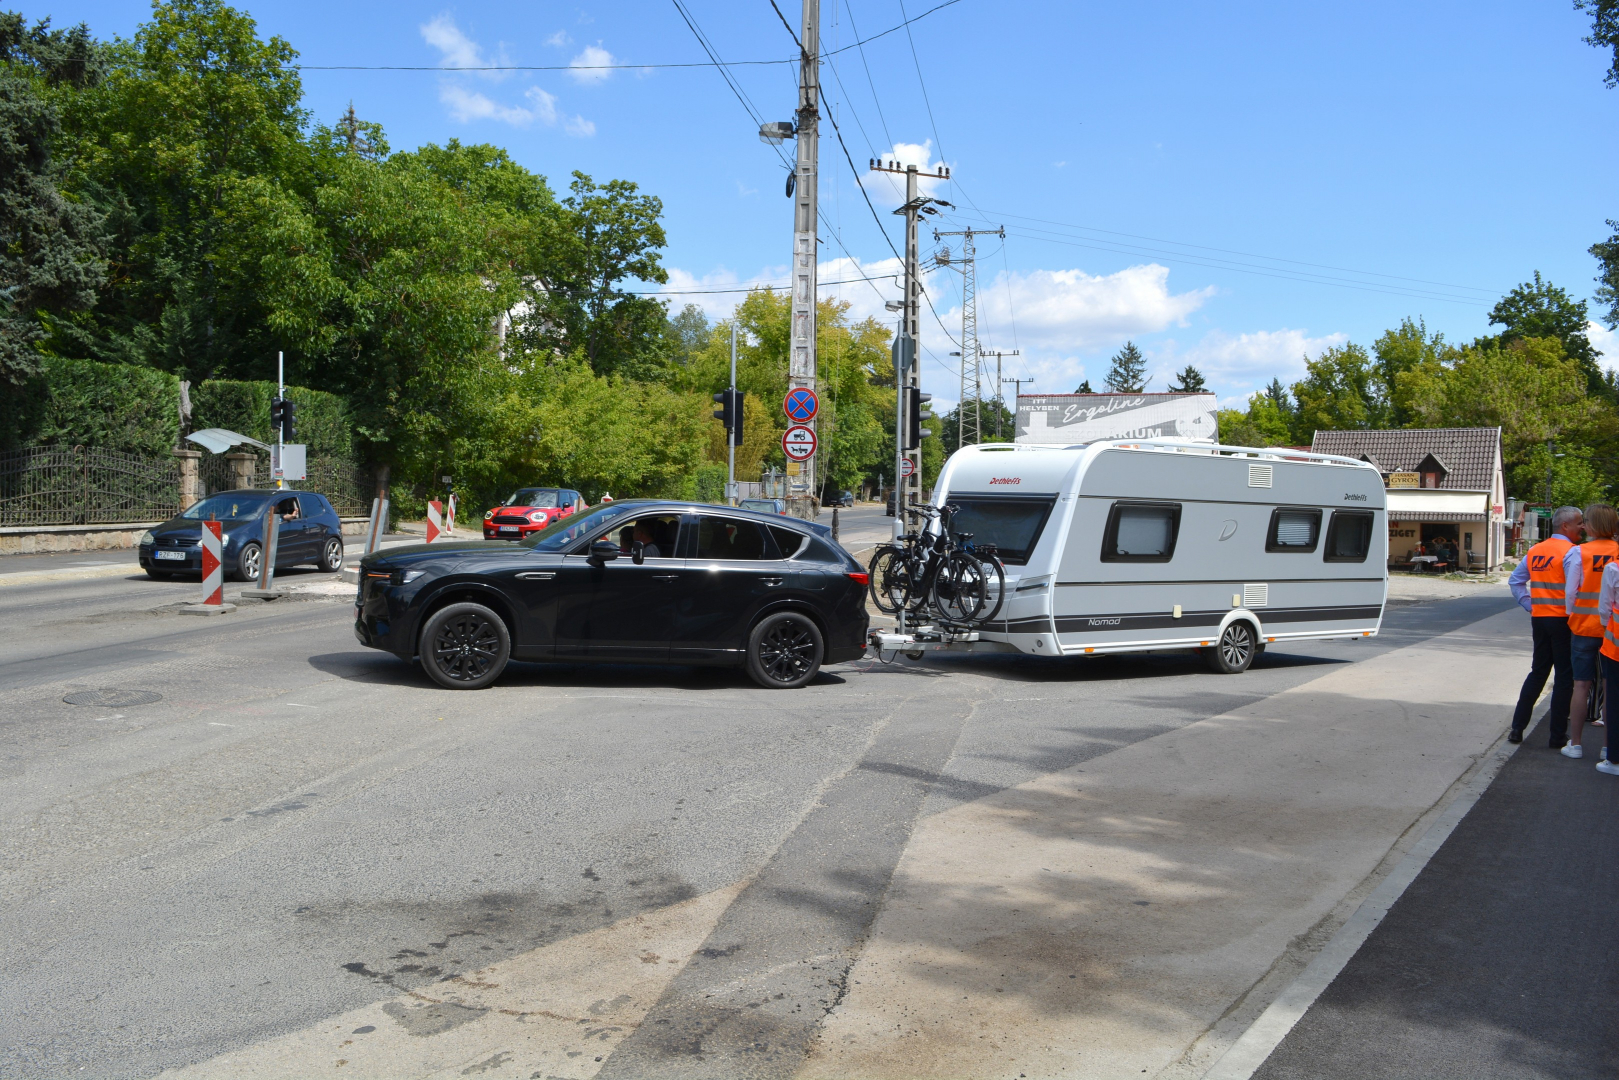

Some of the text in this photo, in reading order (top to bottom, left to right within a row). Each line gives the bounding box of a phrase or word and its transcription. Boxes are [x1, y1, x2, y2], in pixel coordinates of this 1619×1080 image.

[1062, 396, 1146, 423] Ergoline
[989, 477, 1022, 485] Dethleffs
[1343, 493, 1368, 501] Dethleffs
[1388, 529, 1416, 537] ZIGET
[1088, 617, 1122, 626] Nomad
